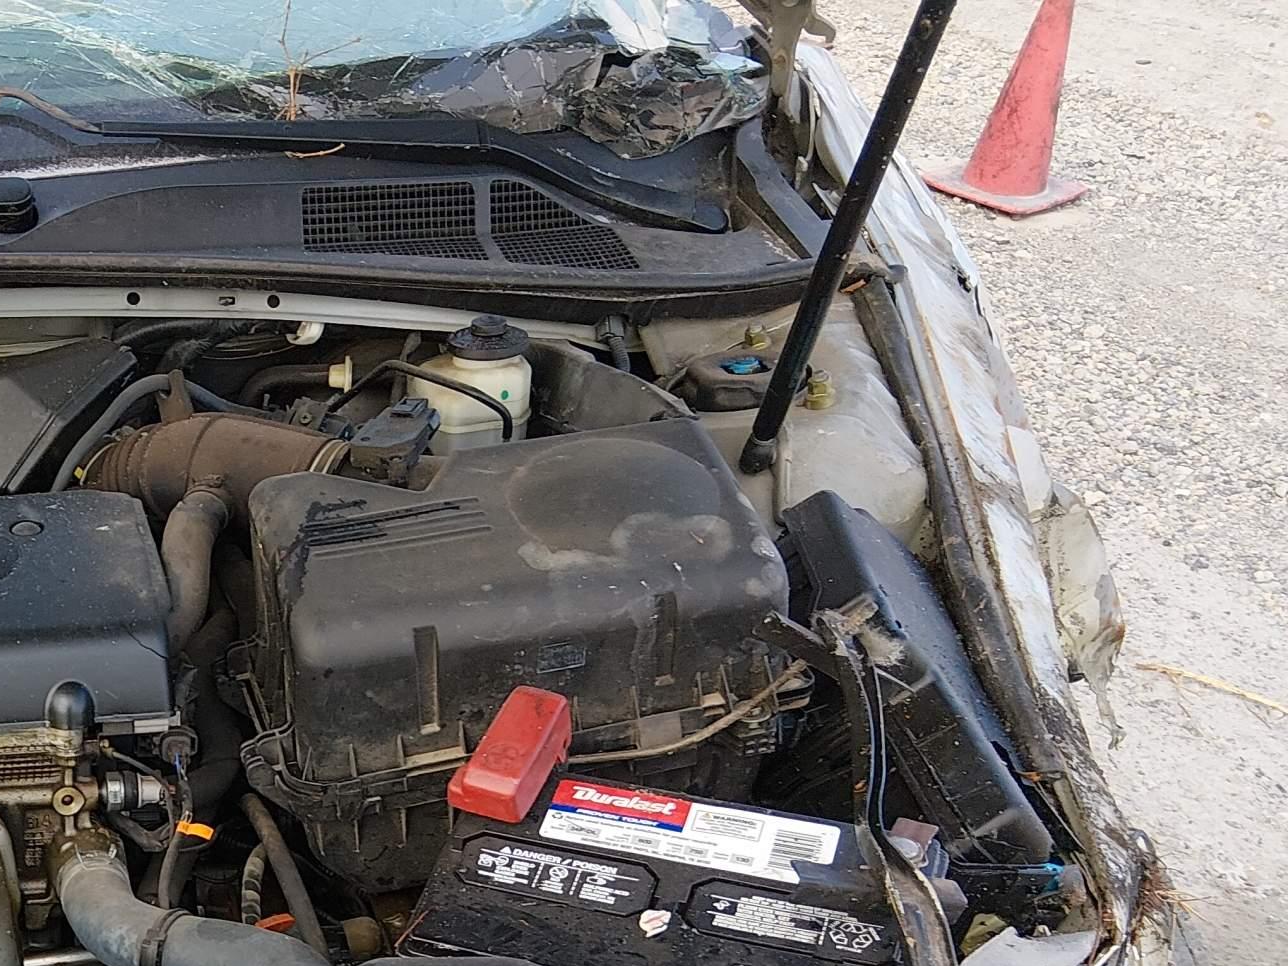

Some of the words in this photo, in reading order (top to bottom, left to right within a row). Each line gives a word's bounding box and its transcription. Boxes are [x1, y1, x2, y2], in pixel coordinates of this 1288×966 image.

[572, 785, 677, 817] Duralast
[576, 808, 621, 821] PROVEN
[622, 815, 660, 827] TOUGH
